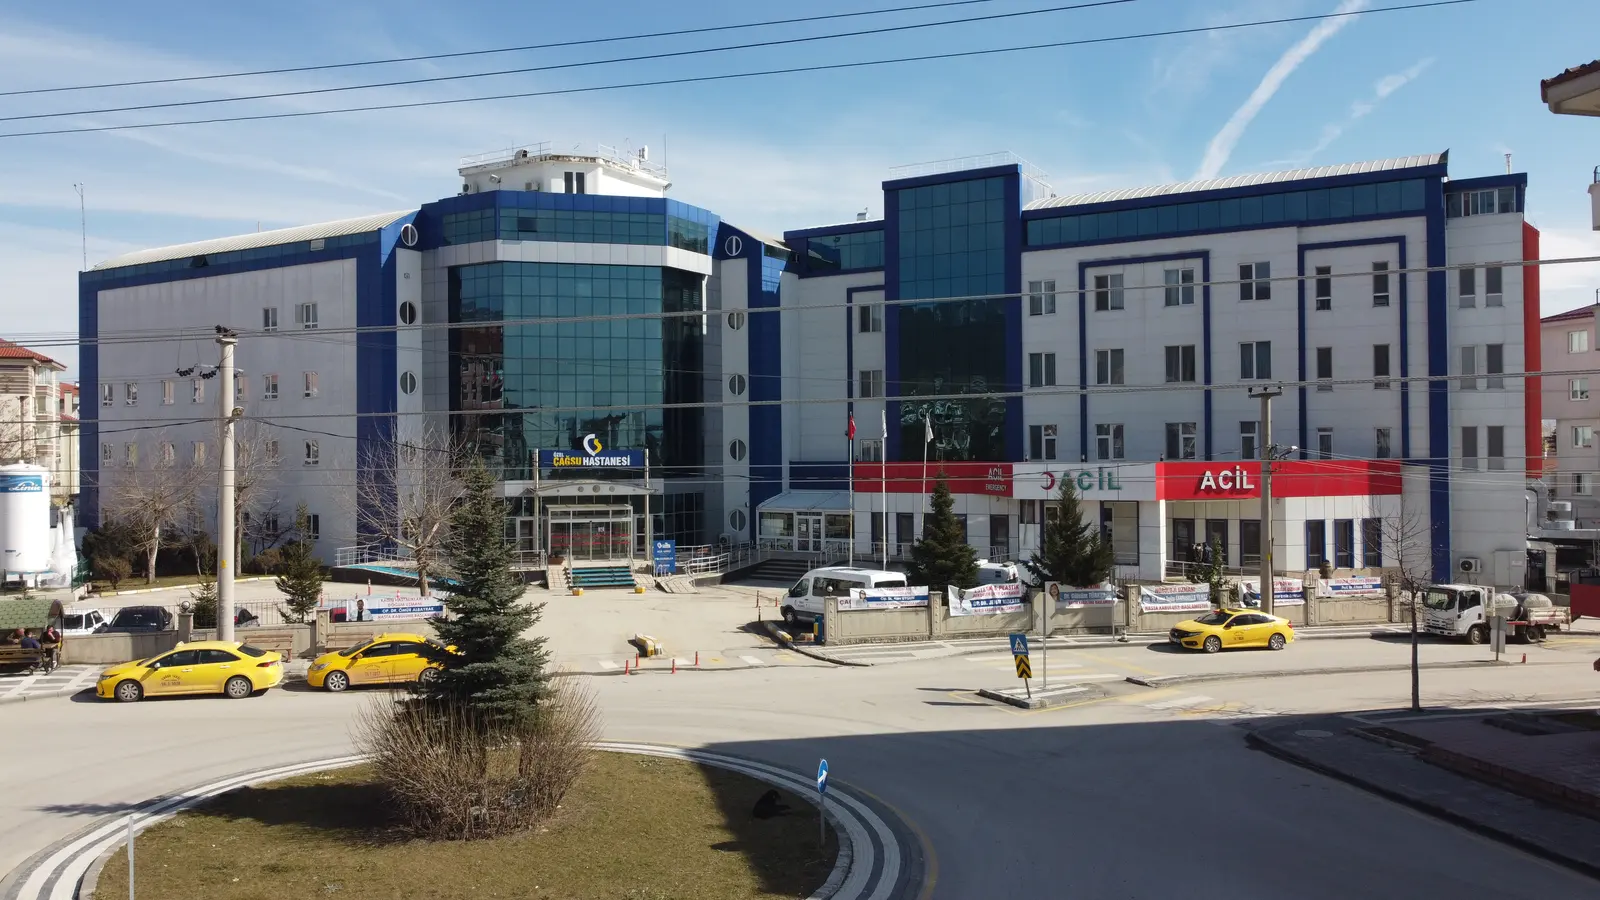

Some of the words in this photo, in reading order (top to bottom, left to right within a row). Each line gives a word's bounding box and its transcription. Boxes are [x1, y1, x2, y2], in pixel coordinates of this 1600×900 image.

[553, 455, 582, 466] ÇAĞSU
[582, 455, 630, 466] HASTANESİ
[1200, 465, 1255, 490] ACİL
[986, 483, 1007, 491] EMERGENCY
